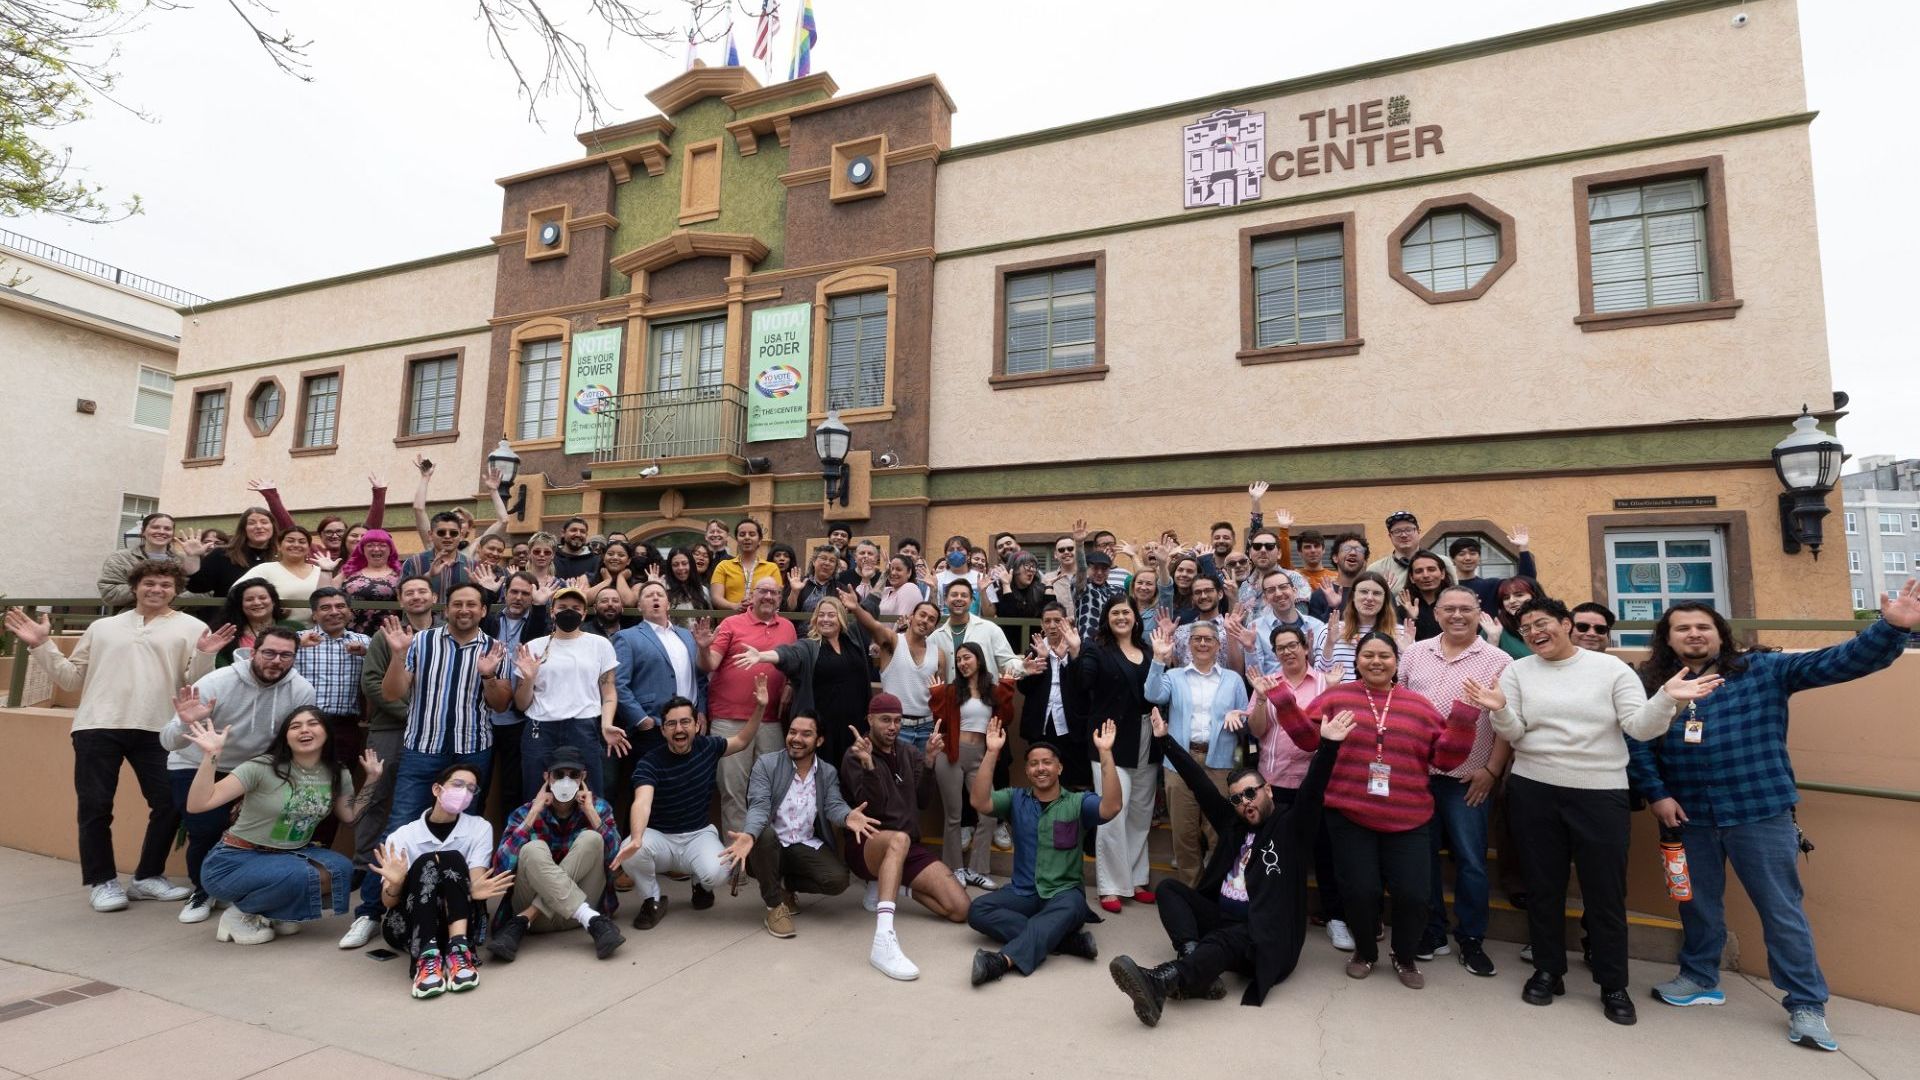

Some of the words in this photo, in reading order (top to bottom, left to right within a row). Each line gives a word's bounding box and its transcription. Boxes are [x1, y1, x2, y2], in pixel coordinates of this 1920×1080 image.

[1299, 99, 1385, 142] THE
[1388, 118, 1411, 127] UNITY
[1267, 124, 1445, 181] CENTER
[756, 308, 805, 332] ¡VOTA!
[576, 334, 617, 354] VOTE!
[764, 333, 782, 344] USA
[784, 331, 796, 341] TU
[759, 341, 800, 358] PODER
[577, 355, 592, 366] USE
[593, 352, 615, 364] YOUR
[577, 362, 613, 378] POWER
[773, 373, 791, 381] VOTE
[586, 390, 605, 398] VOTED
[762, 407, 774, 415] THE
[776, 405, 803, 414] CENTER
